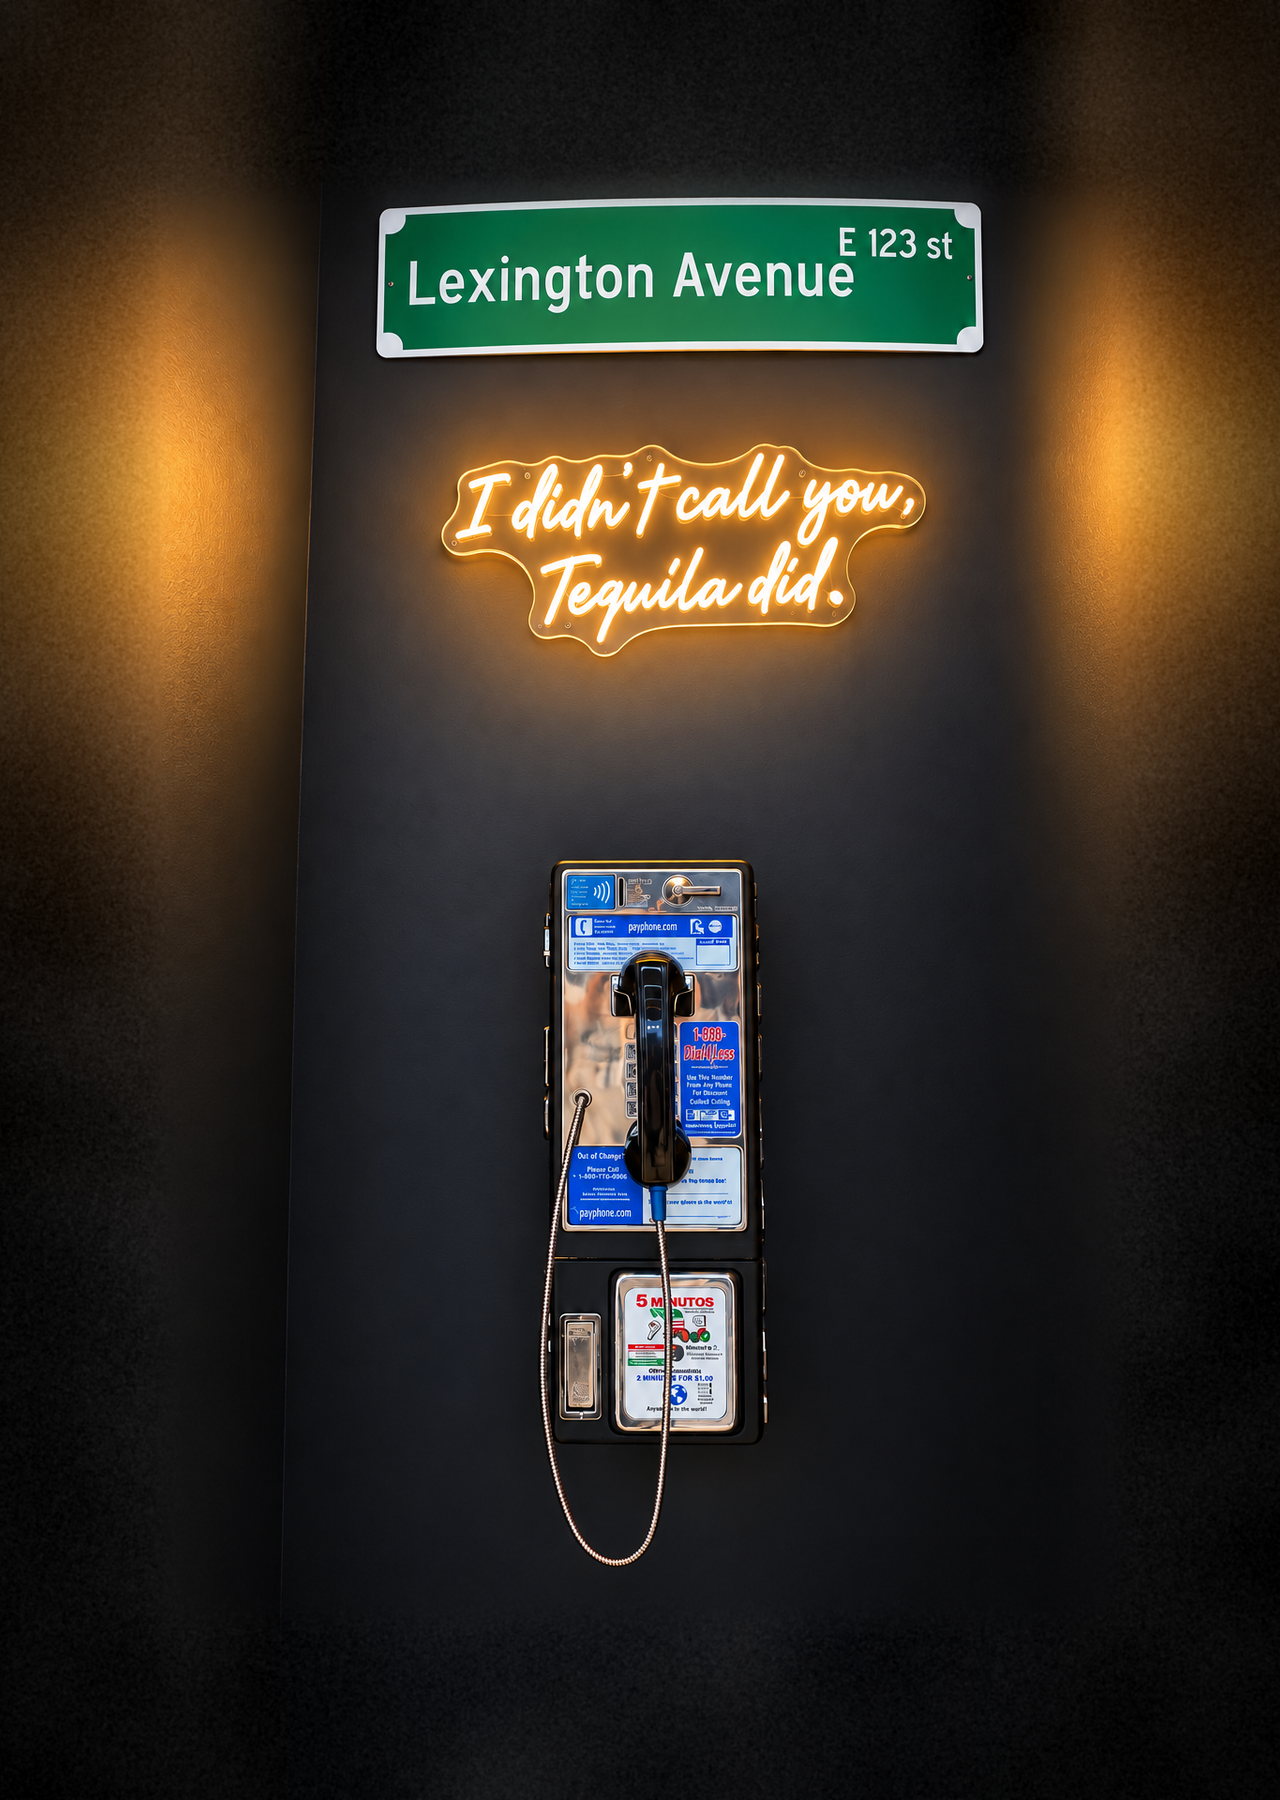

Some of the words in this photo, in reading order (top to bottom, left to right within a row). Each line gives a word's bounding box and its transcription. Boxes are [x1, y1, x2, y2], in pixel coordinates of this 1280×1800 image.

[839, 227, 857, 257] E
[868, 228, 917, 259] 123
[926, 231, 953, 260] st
[408, 254, 654, 314] Lexington
[672, 251, 855, 298] Avenue
[455, 472, 512, 540] I
[675, 452, 791, 522] call
[796, 478, 916, 546] you,
[540, 546, 743, 643] Tequila
[747, 535, 844, 615] did.
[628, 921, 678, 934] payphone.com
[577, 1152, 589, 1160] Out
[579, 1207, 632, 1221] payphone.com
[636, 1294, 648, 1308] 5
[650, 1297, 715, 1308] MNUTOS
